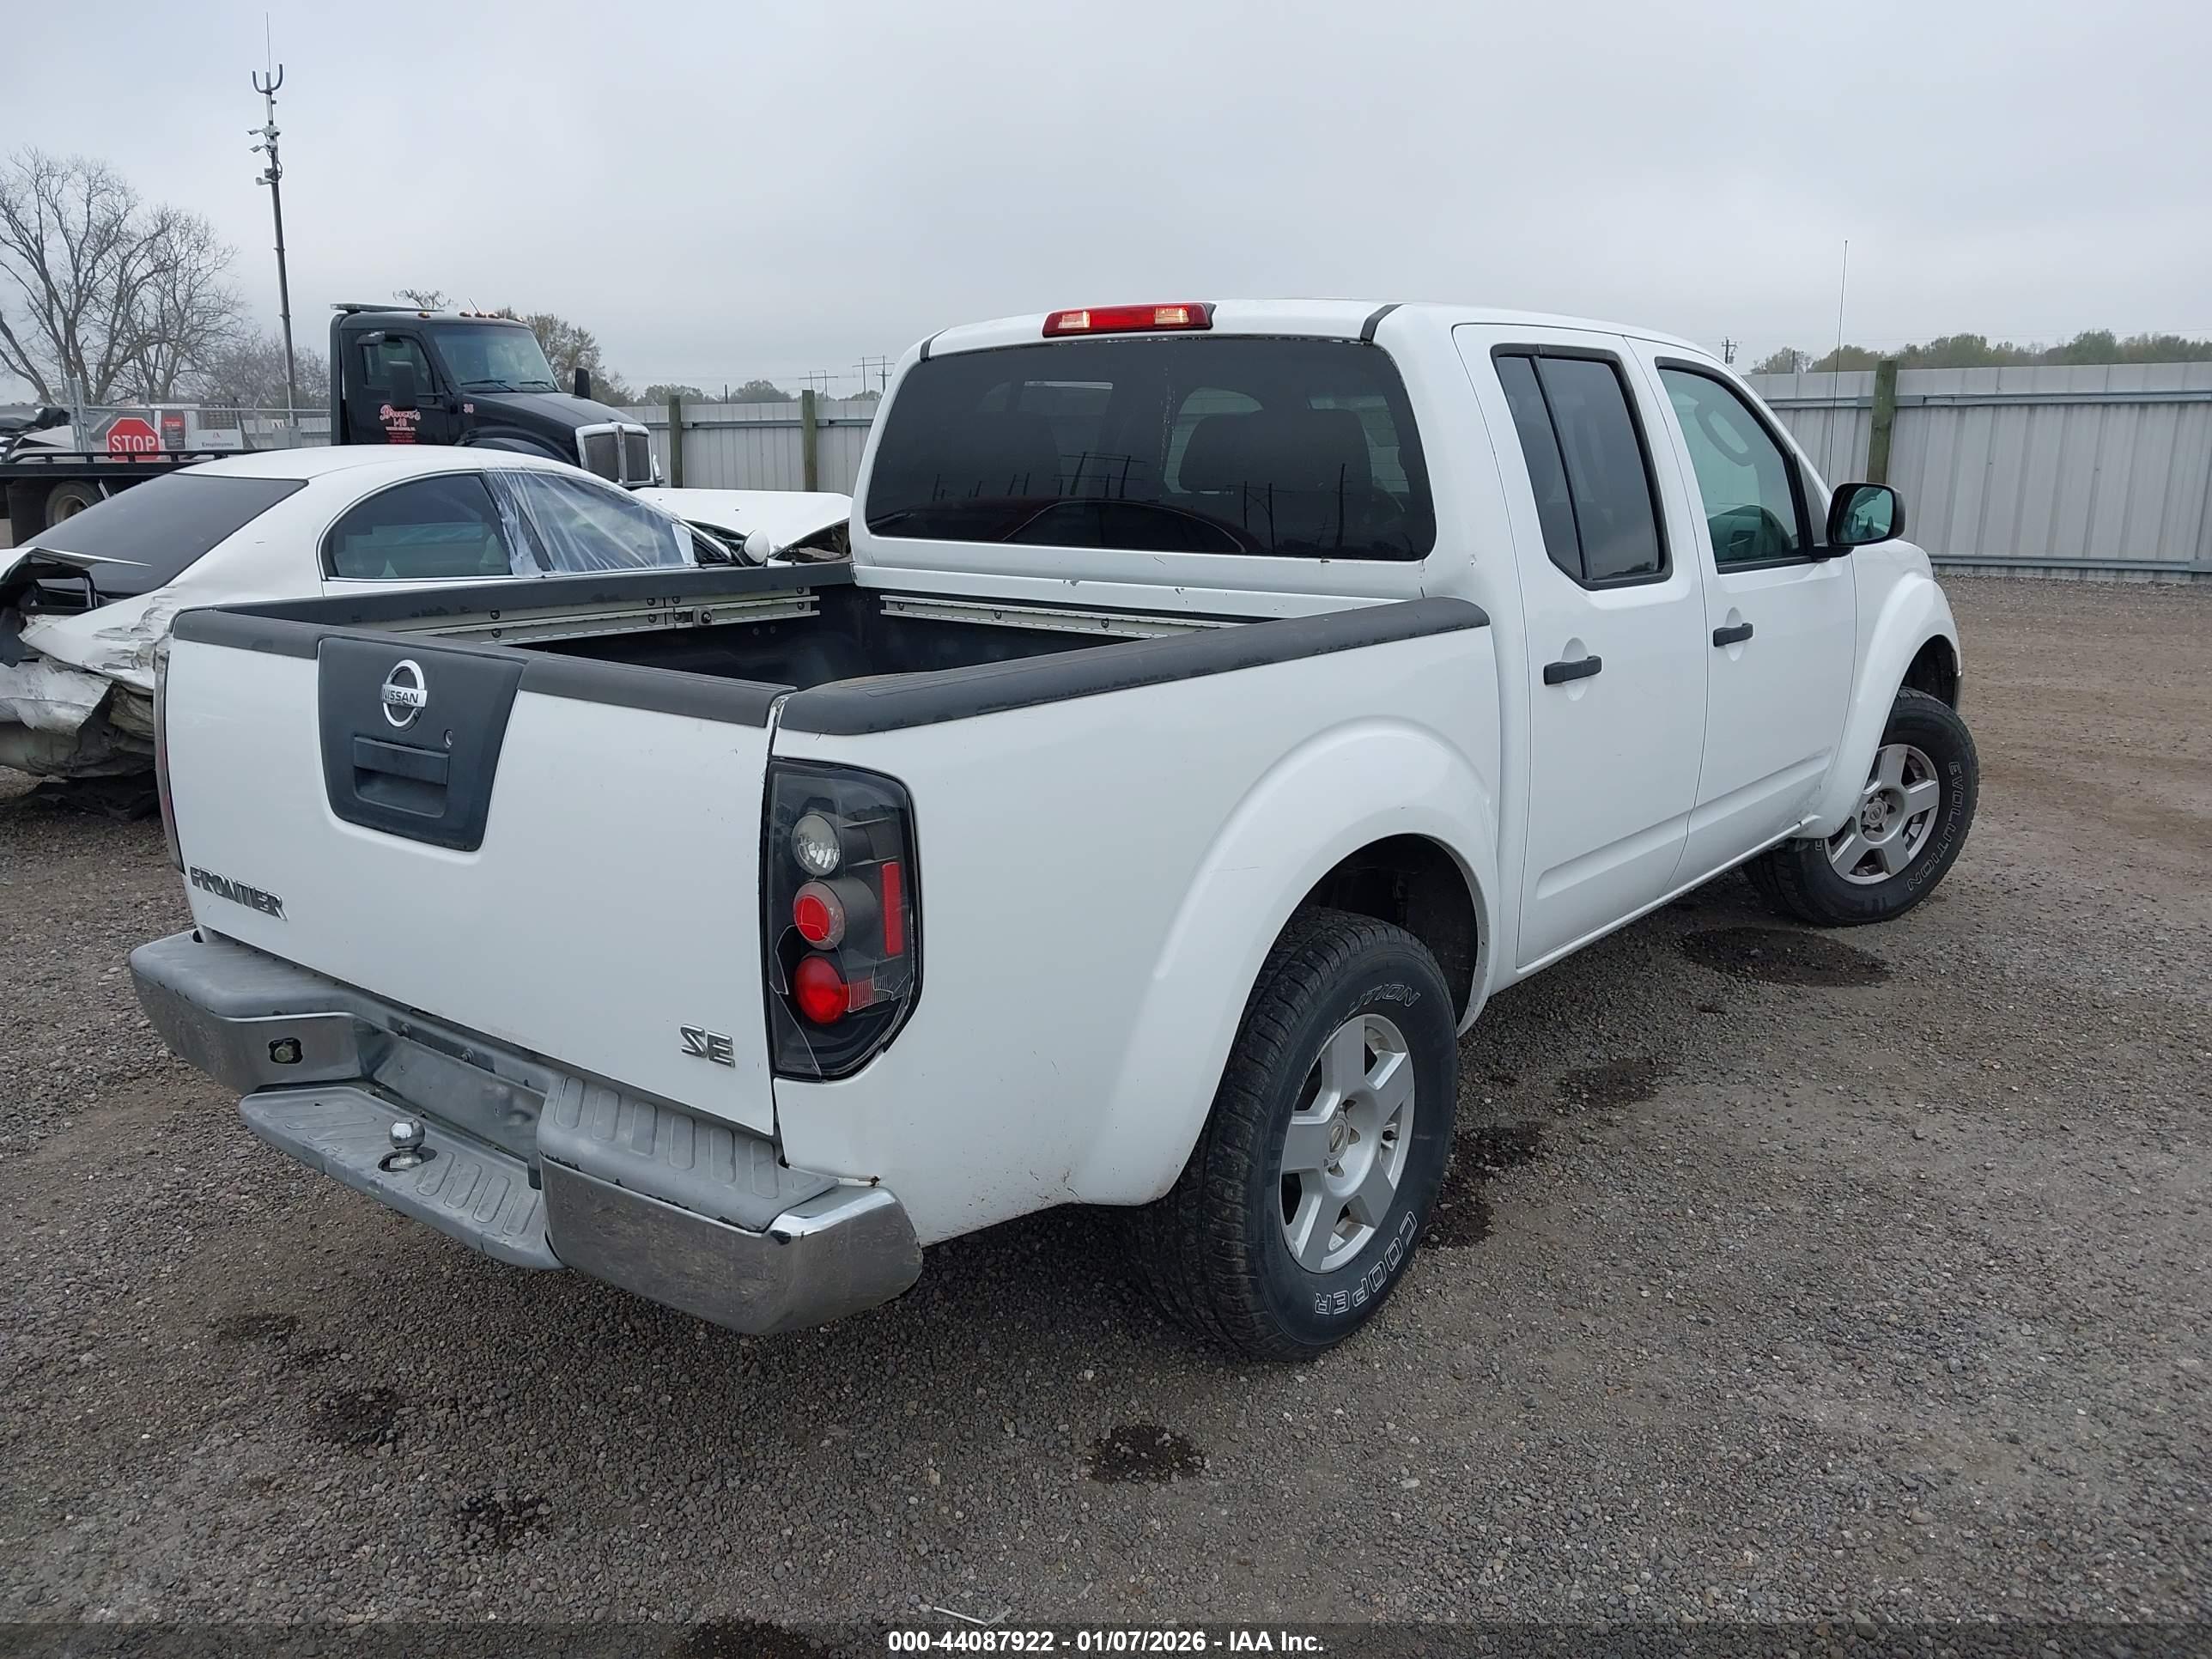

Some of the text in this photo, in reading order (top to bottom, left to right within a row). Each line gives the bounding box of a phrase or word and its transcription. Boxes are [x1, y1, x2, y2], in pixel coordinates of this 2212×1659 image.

[112, 435, 156, 452] STOP
[382, 687, 418, 703] NISSAN
[1906, 761, 1965, 891] EVOLUTION
[190, 865, 289, 921] FRONTIER
[680, 1023, 736, 1068] SE
[1314, 1211, 1418, 1315] COOPER
